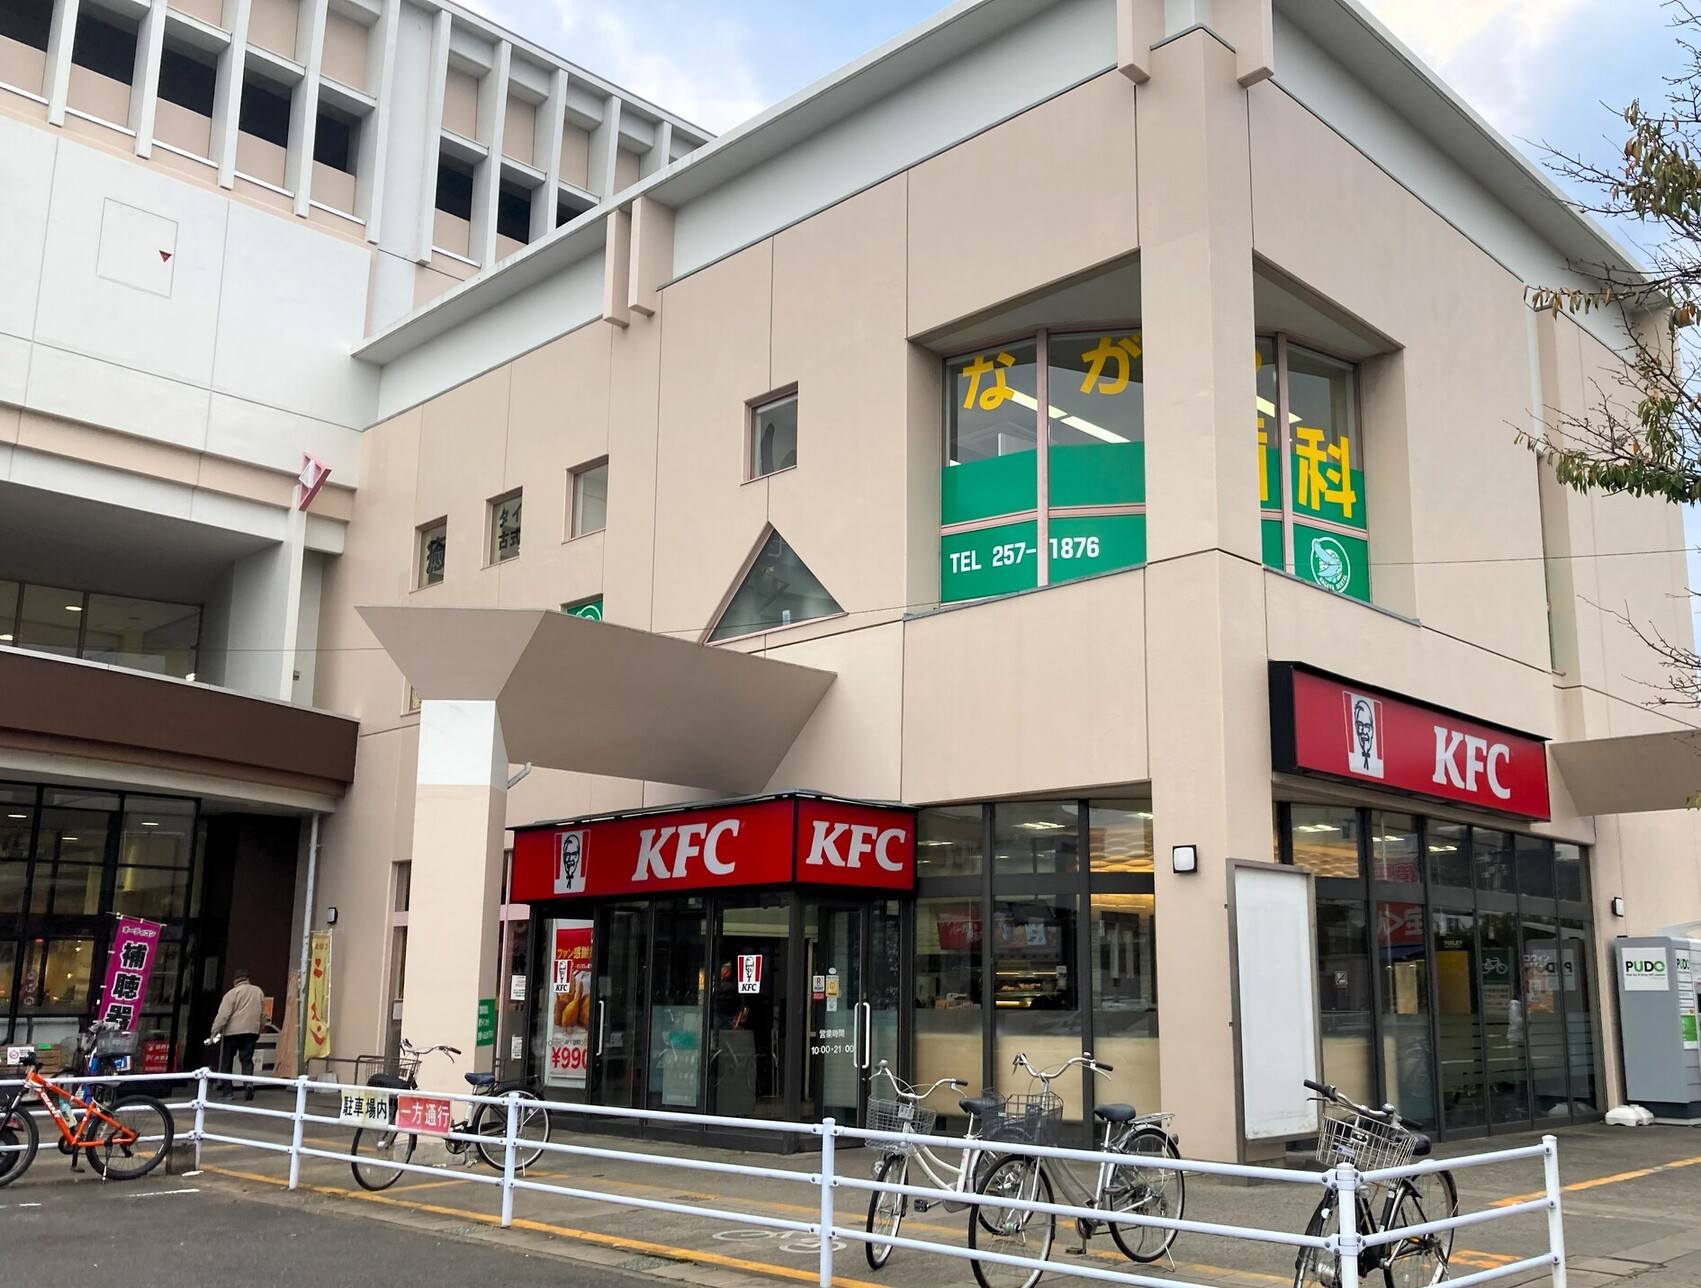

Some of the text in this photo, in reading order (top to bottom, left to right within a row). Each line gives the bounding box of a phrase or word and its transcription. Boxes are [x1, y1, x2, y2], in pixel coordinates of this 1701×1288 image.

[949, 536, 1100, 575] TEL 257-1876
[1432, 725, 1511, 800] KFC
[631, 818, 741, 882] KFC
[805, 820, 906, 872] KFC
[556, 946, 592, 959] ファン感謝
[1625, 960, 1666, 973] PUDO
[104, 940, 149, 1030] 補聴器
[555, 984, 568, 992] KFC
[741, 983, 757, 992] KFC
[819, 1028, 846, 1039] 営業時間
[41, 1092, 61, 1119] GIANT
[342, 1095, 388, 1120] 駐車場内
[400, 1101, 450, 1129] 一方通行
